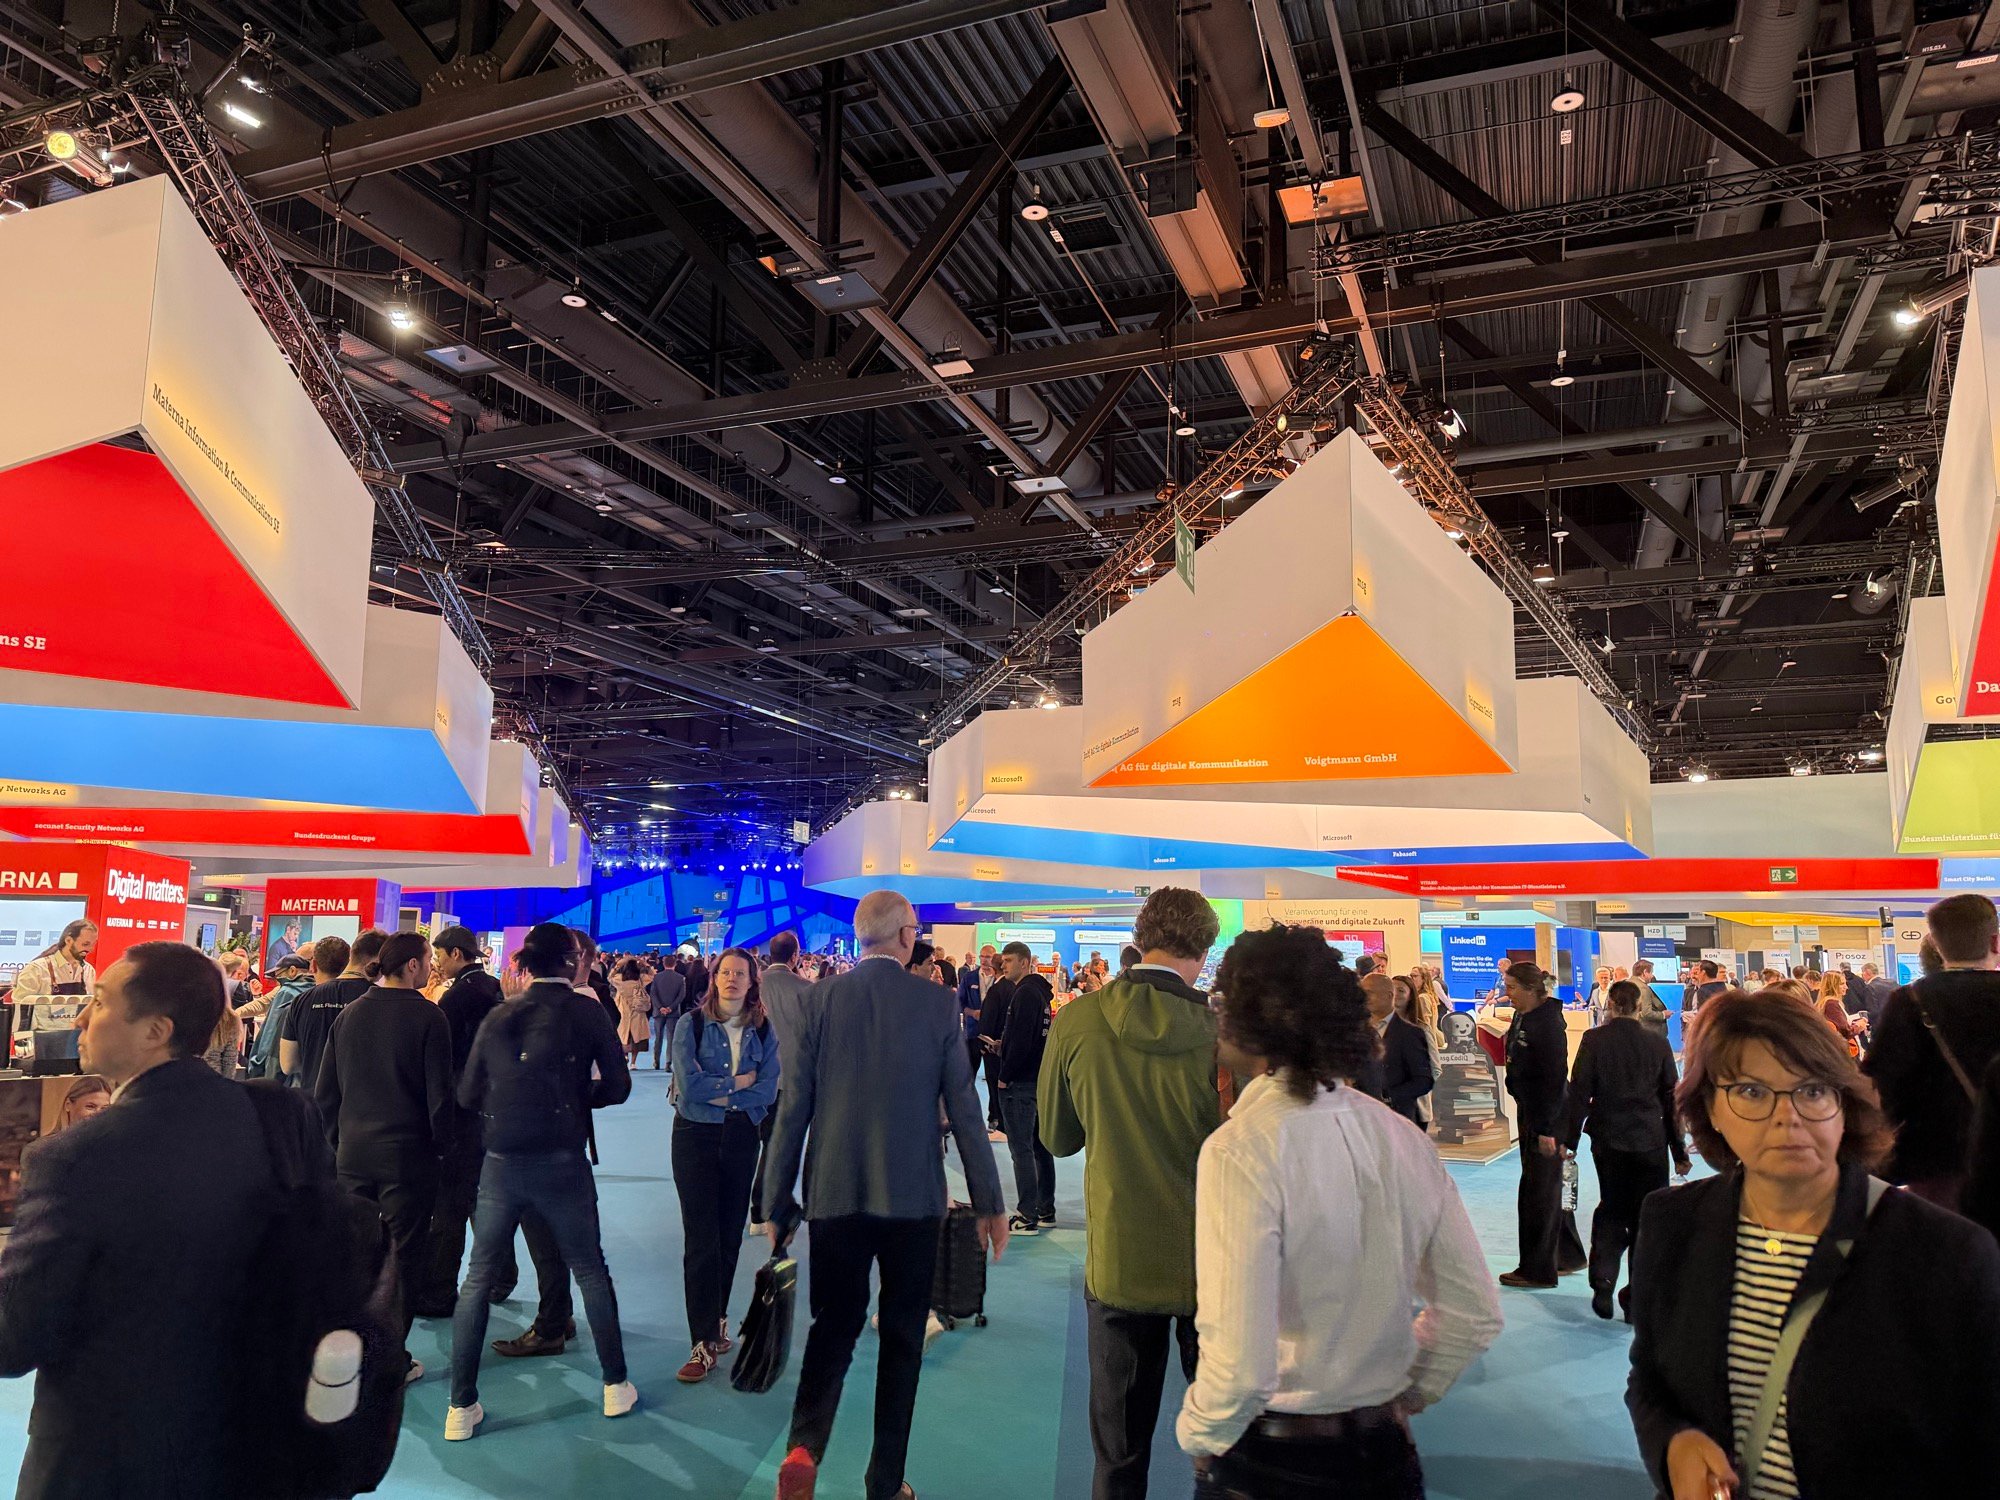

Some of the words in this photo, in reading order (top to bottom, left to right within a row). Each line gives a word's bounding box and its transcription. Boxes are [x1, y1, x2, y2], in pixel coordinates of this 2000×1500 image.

[152, 383, 184, 429] Materna
[185, 418, 224, 473] Information
[224, 462, 230, 480] &
[230, 471, 273, 526] Communications
[273, 517, 280, 534] SE
[23, 635, 47, 650] SE
[1975, 681, 2000, 694] Da
[1119, 762, 1134, 772] AG
[1135, 762, 1149, 771] für
[1151, 760, 1187, 773] digitale
[1188, 758, 1269, 770] Kommunikation
[1304, 755, 1362, 768] Voigtmann
[1363, 753, 1398, 763] GmbH
[990, 775, 1023, 783] Microsoft
[6, 785, 51, 795] Networks
[52, 788, 67, 796] AG
[65, 823, 96, 833] Security
[97, 824, 132, 832] Networks
[294, 832, 350, 841] Bundesdruckerei
[351, 834, 376, 842] Gruppe
[1904, 834, 1987, 843] Bundesministerium
[0, 870, 53, 889] RNA
[107, 868, 143, 904] Digital
[144, 876, 185, 904] matters.
[281, 899, 345, 911] MATERNA
[1284, 907, 1338, 917] Verantwortung
[1339, 907, 1351, 915] für
[1341, 917, 1371, 927] digitale
[1372, 918, 1405, 926] Zukunft
